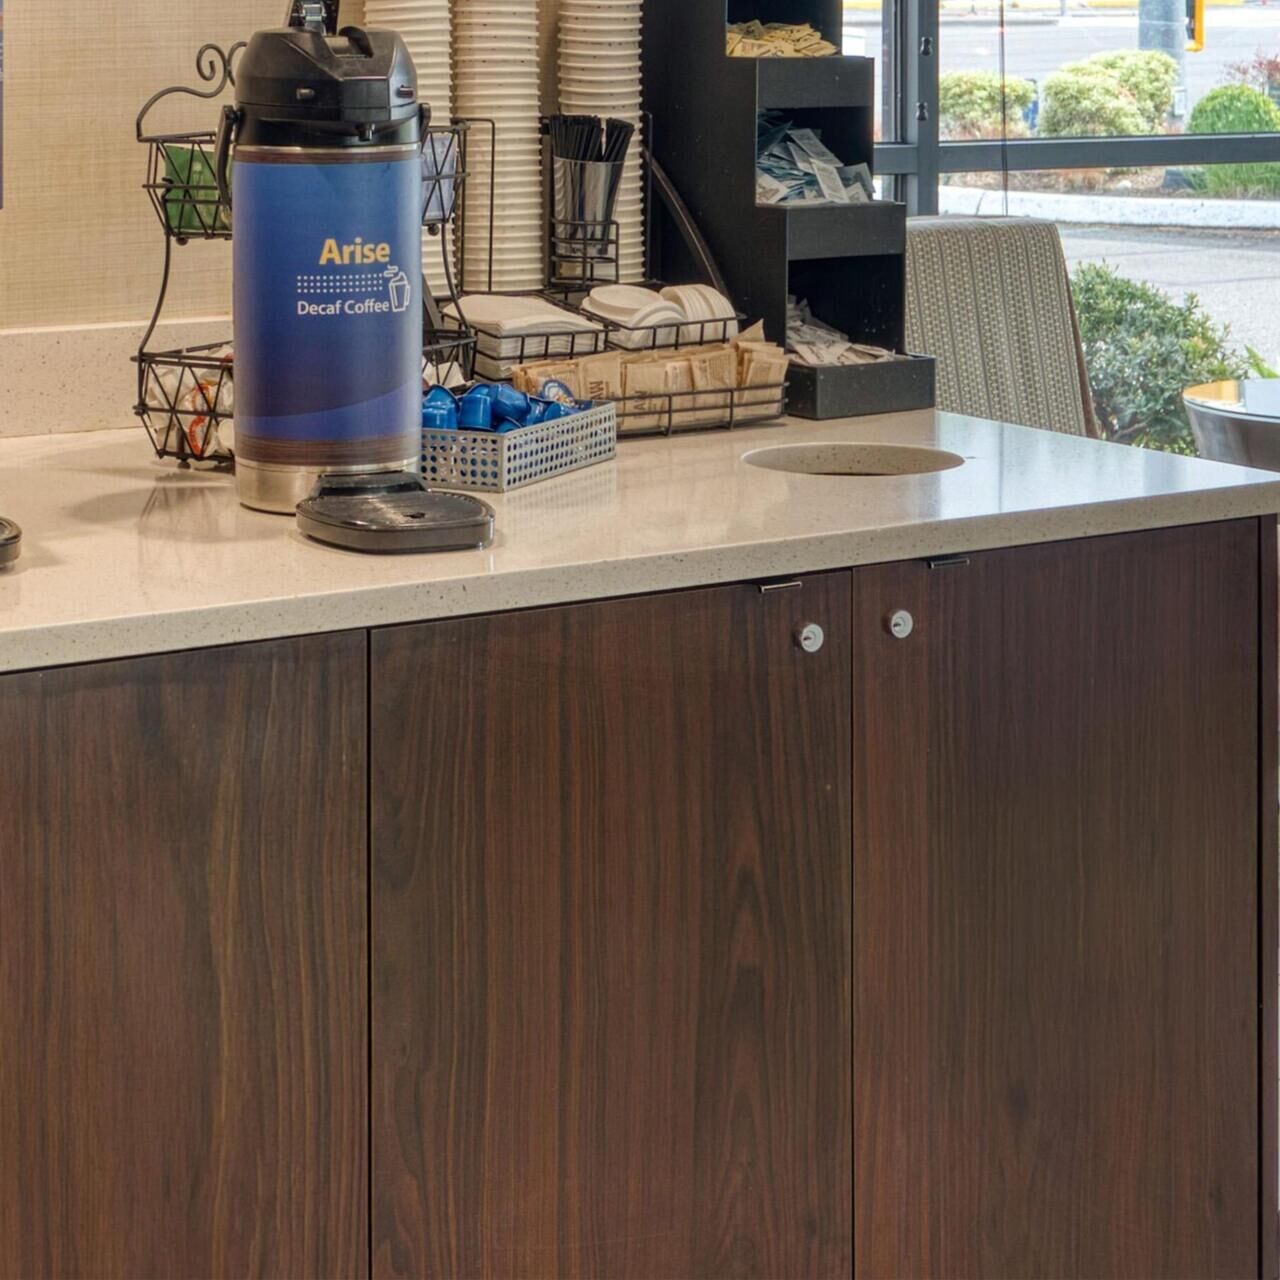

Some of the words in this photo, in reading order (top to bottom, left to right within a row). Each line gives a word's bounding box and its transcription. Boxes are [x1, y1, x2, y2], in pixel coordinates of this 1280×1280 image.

[319, 237, 391, 265] Arise
[297, 300, 342, 315] Decaf
[344, 298, 390, 314] Coffee
